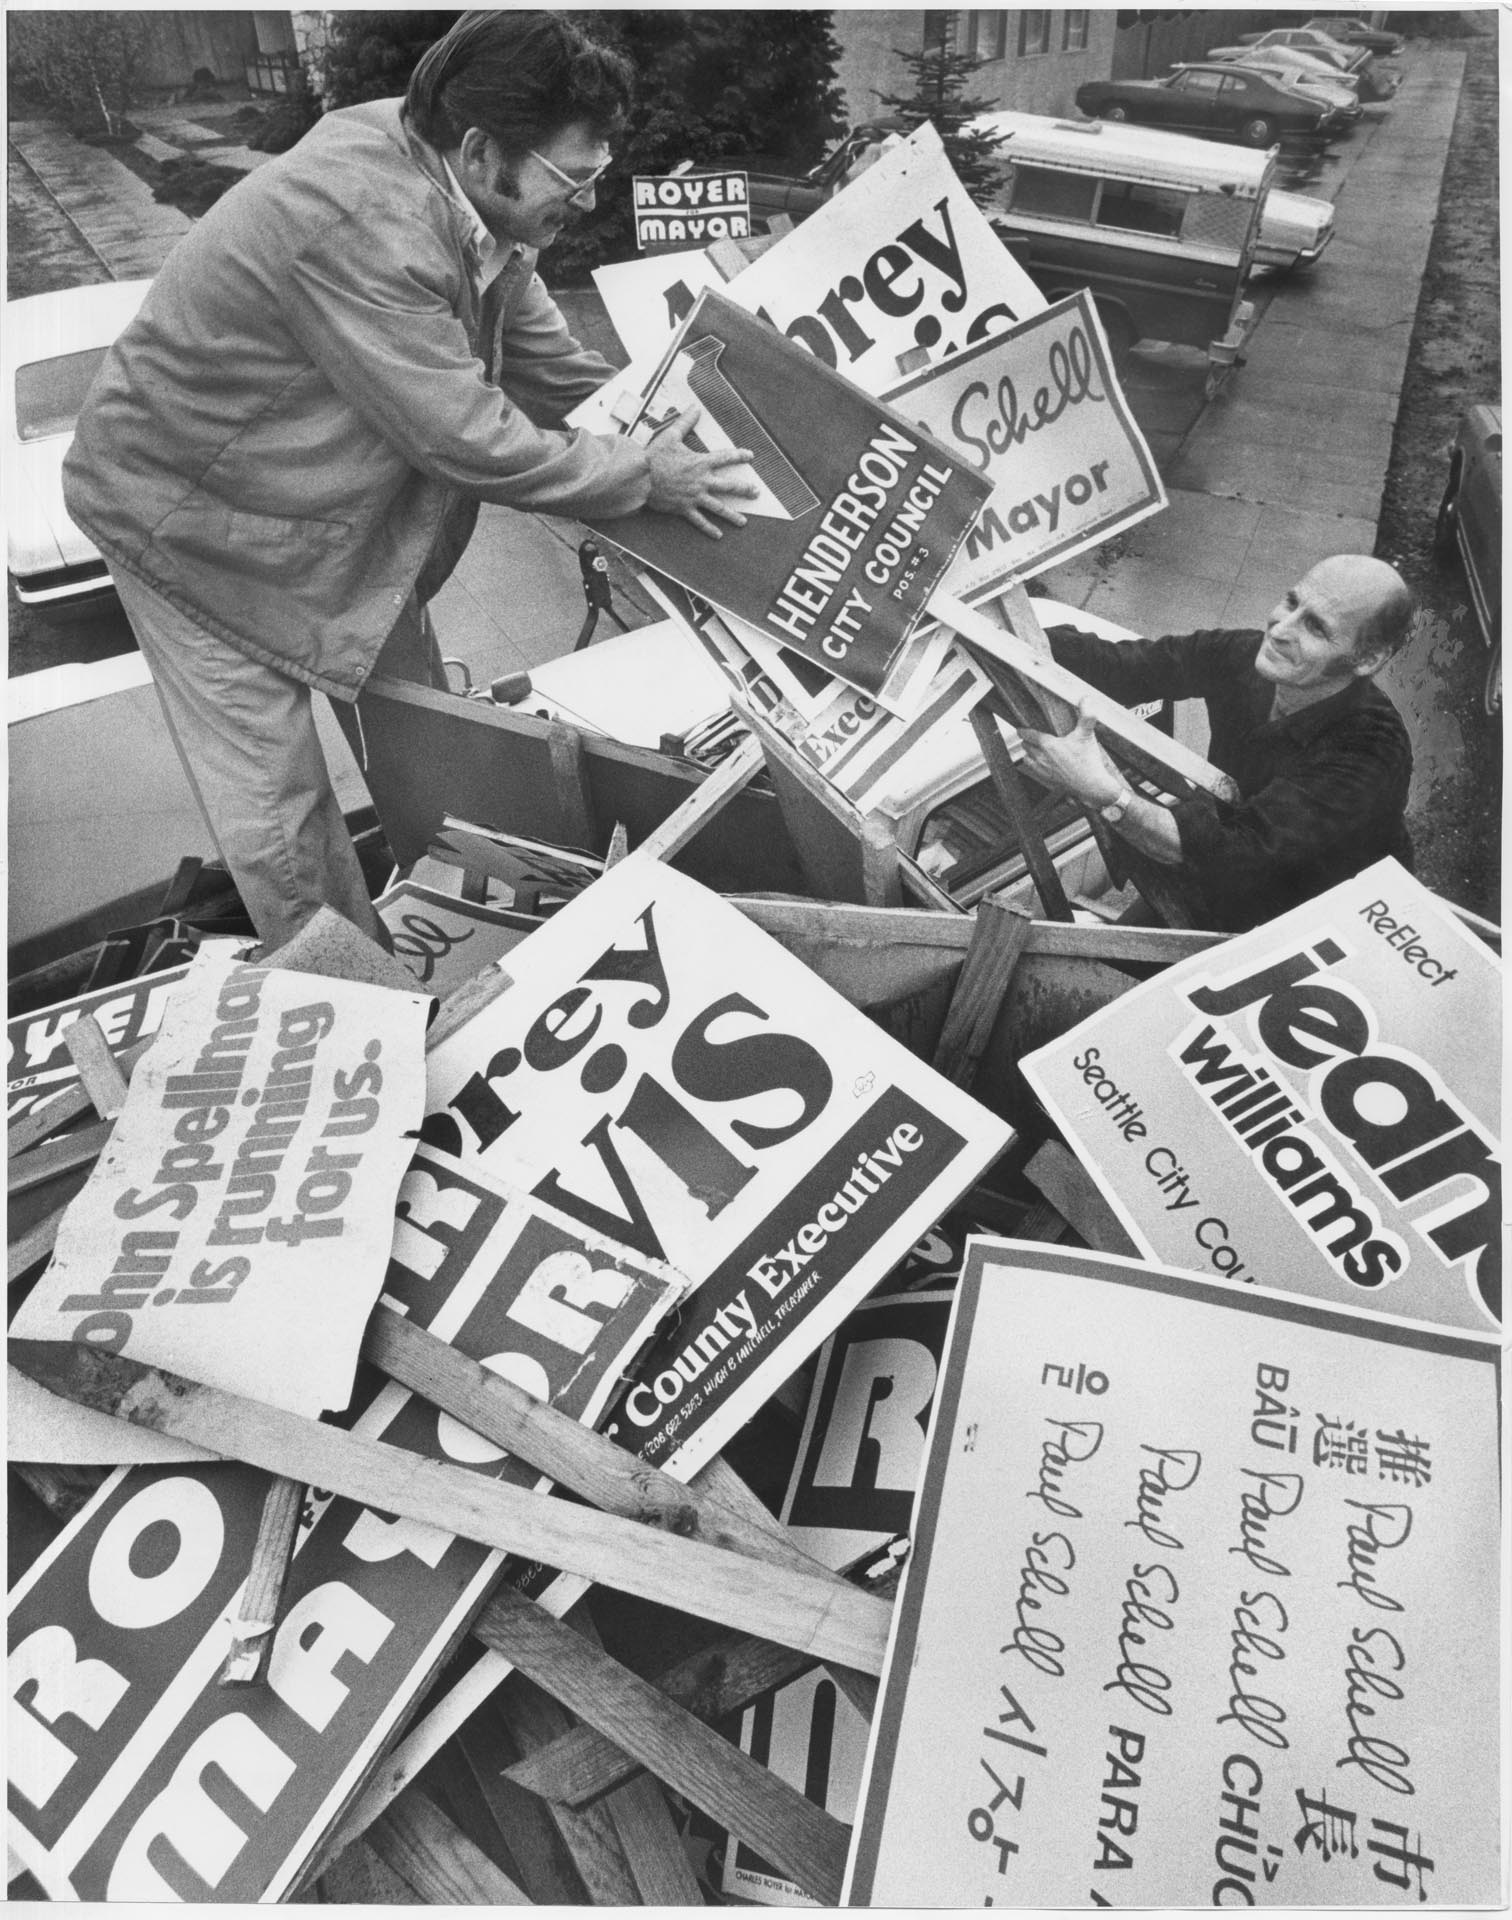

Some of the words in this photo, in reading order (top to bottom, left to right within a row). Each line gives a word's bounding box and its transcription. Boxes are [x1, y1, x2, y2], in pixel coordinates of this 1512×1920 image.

[636, 178, 746, 206] ROYER
[640, 216, 749, 241] MAYOR
[951, 327, 1105, 473] Schell
[767, 422, 919, 641] HENDERSON
[822, 587, 873, 661] CITY
[864, 463, 953, 586] COUNCIL
[965, 460, 1110, 560] Mayor
[1358, 899, 1459, 988] ReElect
[8, 1076, 38, 1090] OR
[113, 963, 273, 1222] Spellman
[152, 1256, 252, 1307] is
[206, 1001, 336, 1246] running
[265, 1144, 365, 1248] for
[320, 1038, 383, 1138] us.
[1073, 1047, 1147, 1143] Seattle
[1145, 1147, 1200, 1211] City
[1179, 1024, 1402, 1288] williams
[1187, 937, 1503, 1263] jean
[624, 1290, 760, 1429] County
[746, 1122, 923, 1299] Executive
[700, 1365, 730, 1397] HUGH
[1026, 1417, 1104, 1519] Paul
[1124, 1444, 1202, 1550] Paul
[1229, 1467, 1304, 1577] Paul
[1001, 1531, 1077, 1678] Schell
[1336, 1498, 1413, 1614] Paul
[1103, 1563, 1181, 1717] Schell
[1216, 1590, 1290, 1751] Schell
[1336, 1626, 1416, 1797] Schell
[1093, 1724, 1146, 1870] PARA
[1294, 1786, 1435, 1903] 市長
